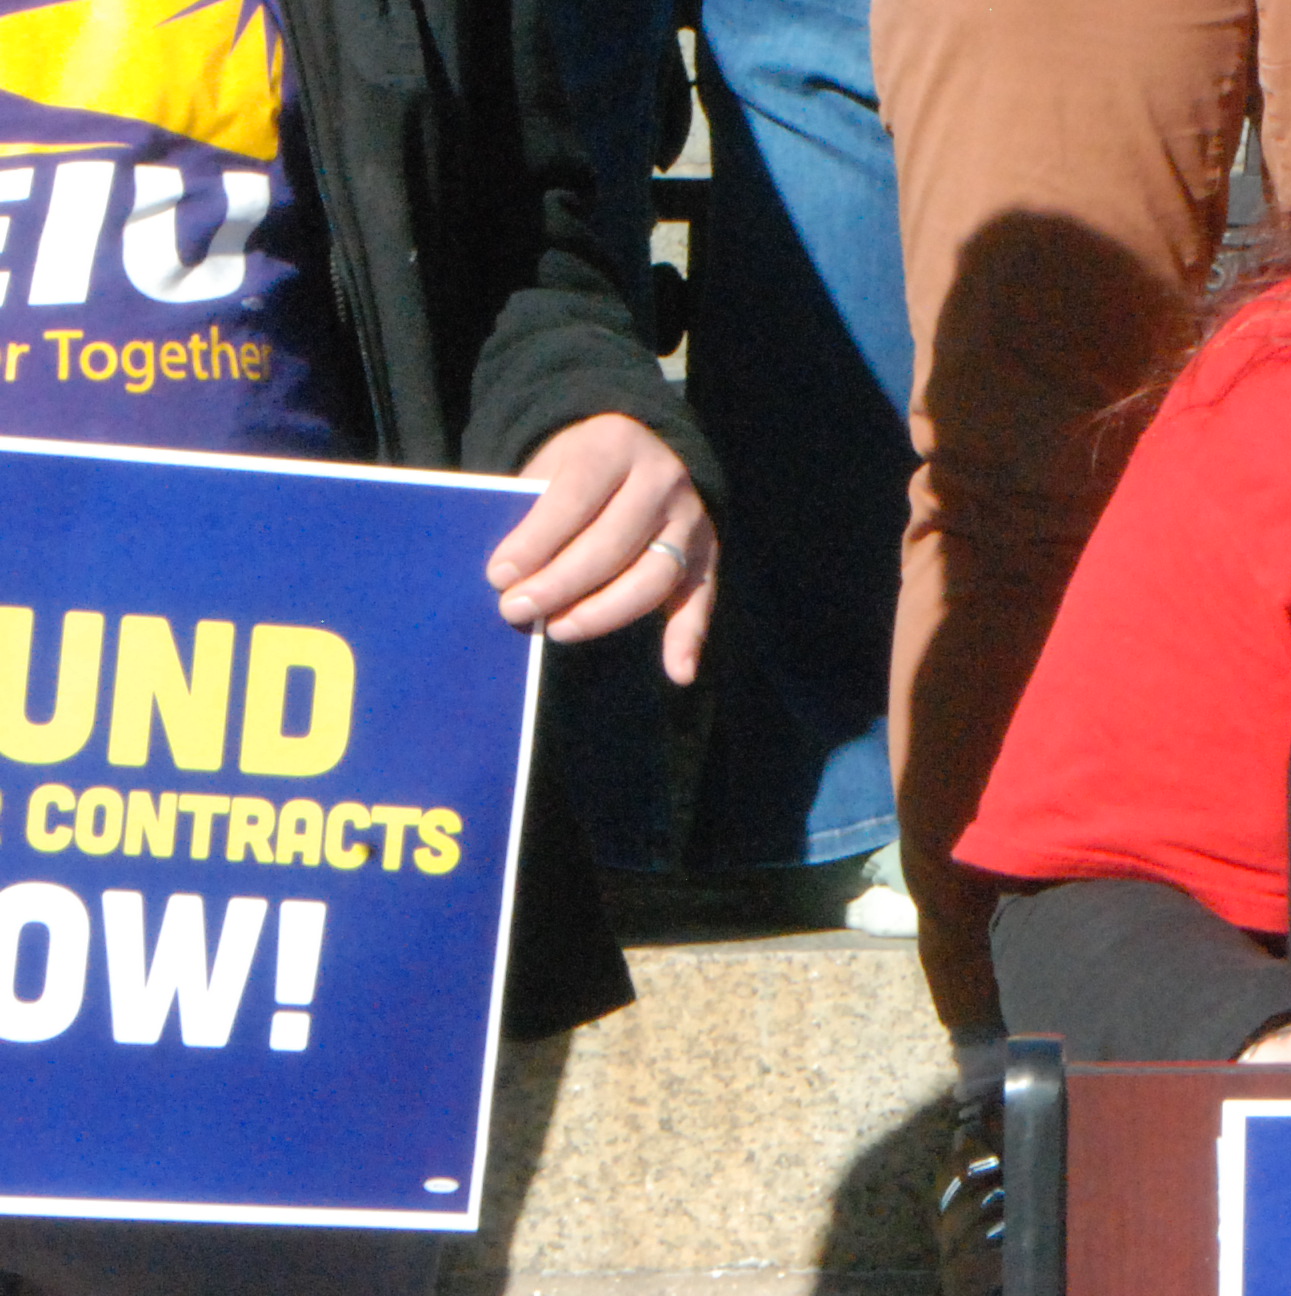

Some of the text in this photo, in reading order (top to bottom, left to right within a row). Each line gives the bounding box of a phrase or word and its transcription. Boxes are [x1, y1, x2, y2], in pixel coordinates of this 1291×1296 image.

[0, 604, 356, 778] UND
[26, 784, 463, 875] CONTRACTS
[0, 882, 326, 1052] OW!
